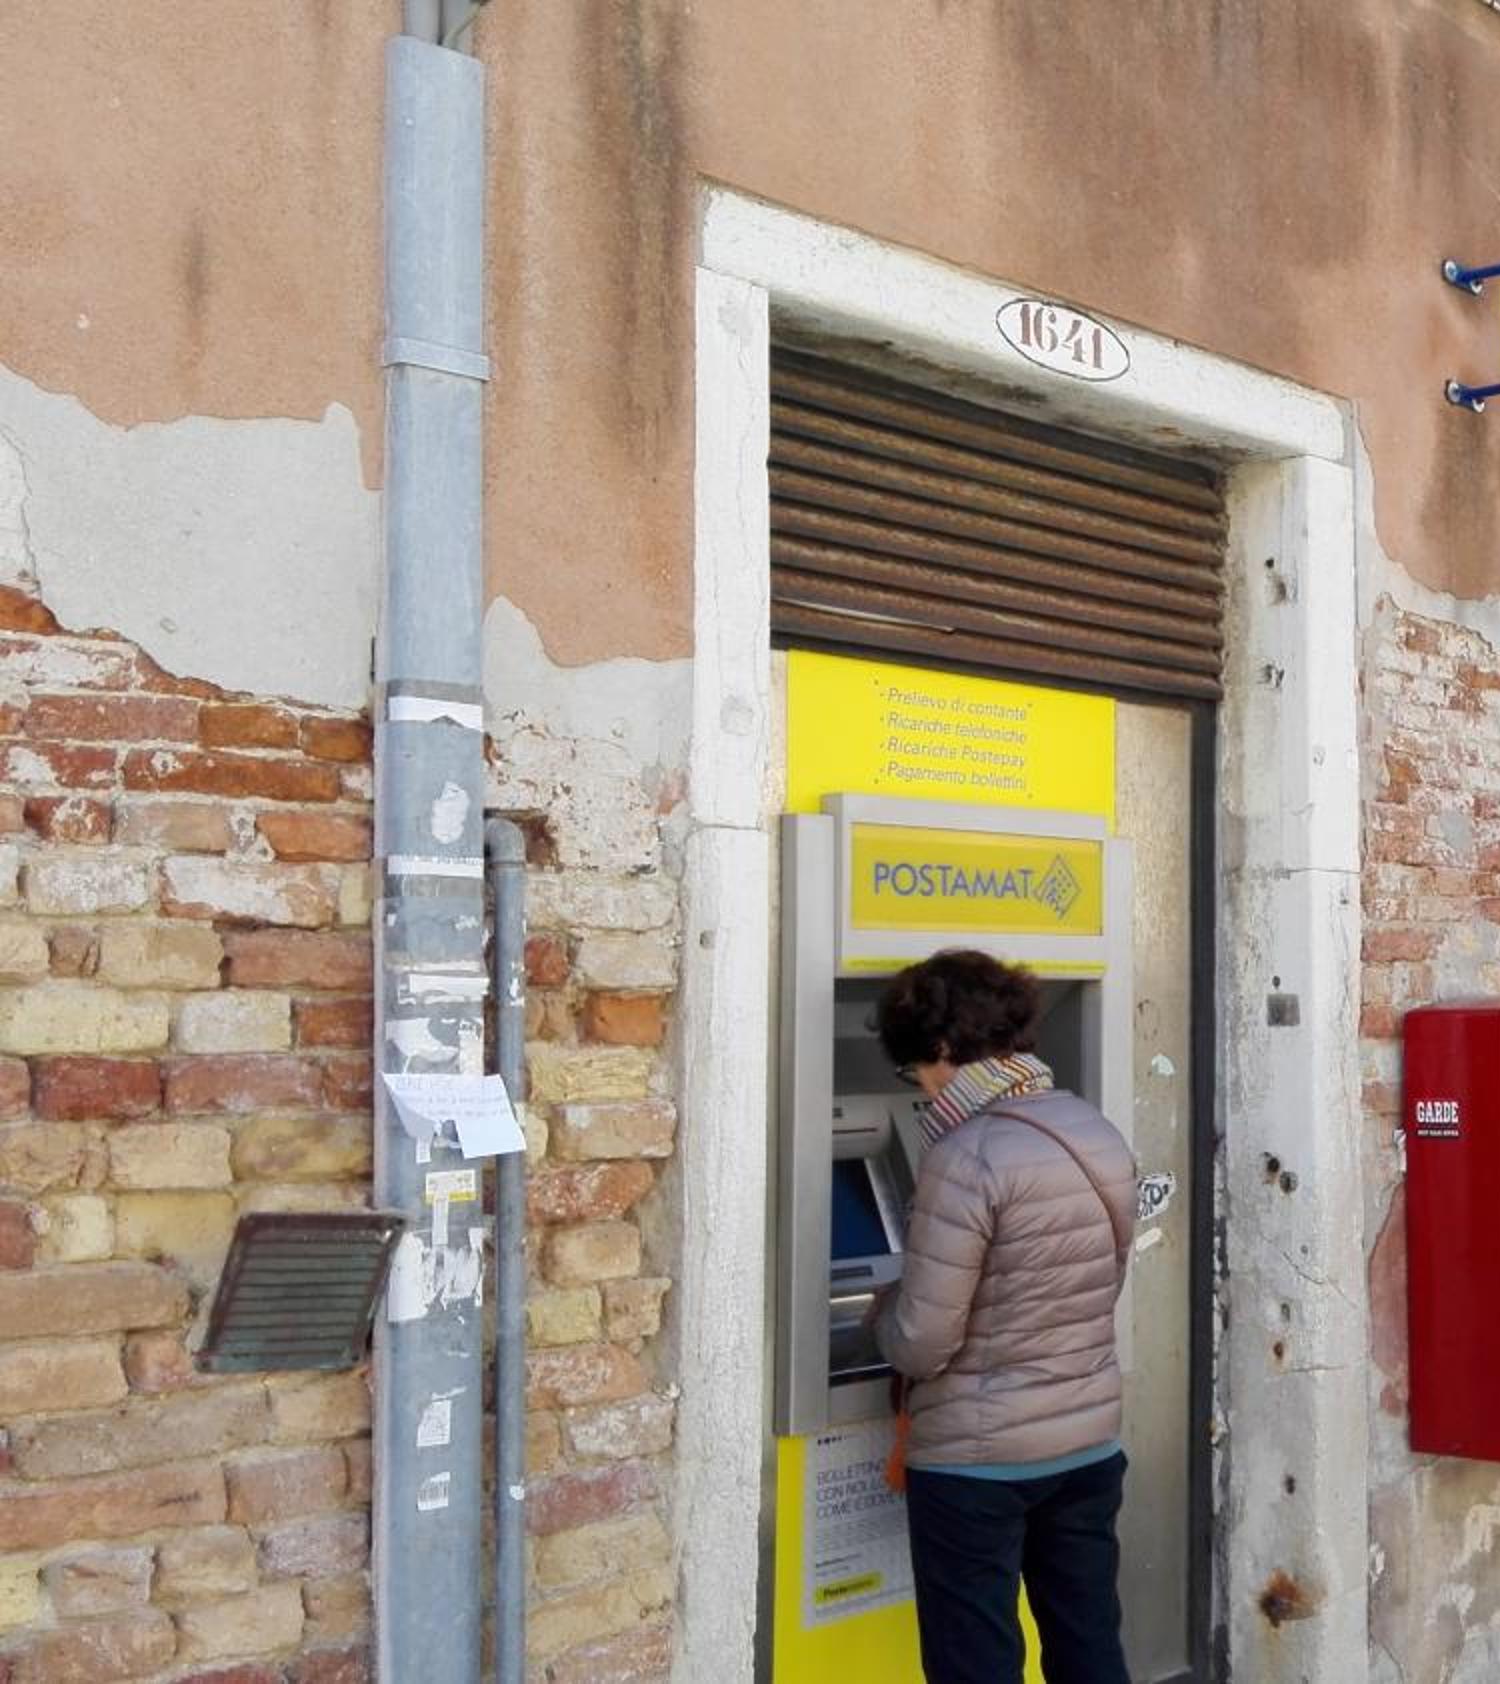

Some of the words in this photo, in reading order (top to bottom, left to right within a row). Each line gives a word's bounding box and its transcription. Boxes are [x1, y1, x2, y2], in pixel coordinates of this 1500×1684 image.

[1020, 303, 1104, 370] 1641
[888, 687, 946, 710] Prelievo
[951, 696, 965, 713] di
[887, 711, 952, 735] Ricariche
[955, 722, 1025, 745] telefoniche
[887, 736, 957, 760] Ricariche
[961, 745, 1025, 770] Postepay
[887, 760, 966, 785] Pagamento
[970, 771, 1025, 790] bollettini
[874, 862, 1035, 899] POSTAMAT
[1417, 1101, 1459, 1123] GARDE
